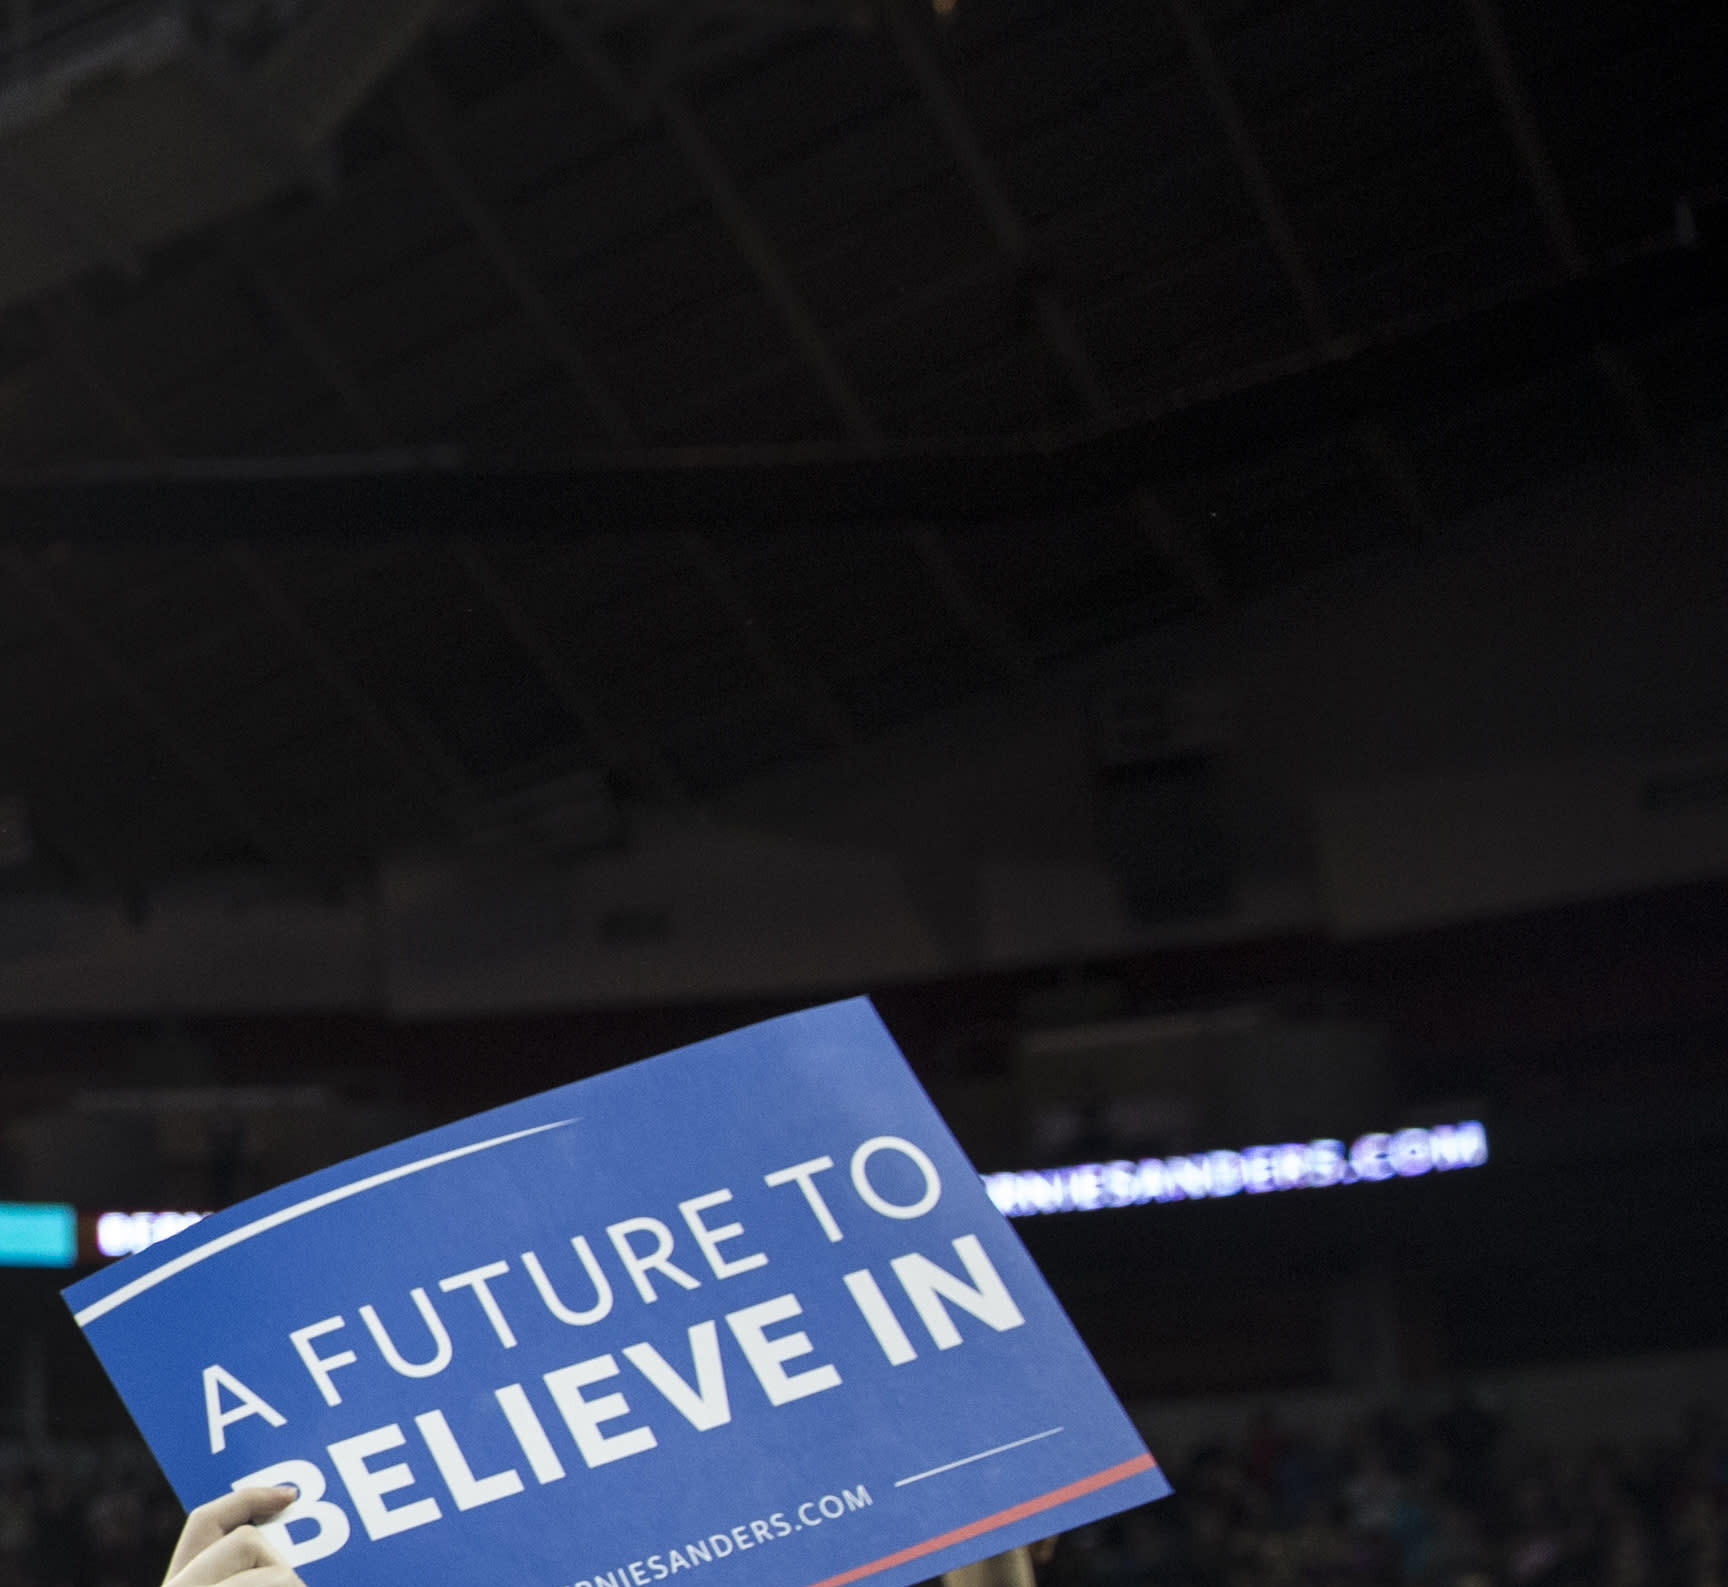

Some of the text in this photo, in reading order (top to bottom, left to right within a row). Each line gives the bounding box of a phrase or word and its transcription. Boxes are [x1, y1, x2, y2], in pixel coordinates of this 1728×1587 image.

[204, 1365, 286, 1453] A
[290, 1189, 768, 1406] FUTURE
[765, 1136, 941, 1242] TO
[230, 1235, 1025, 1569] BELIEVE IN
